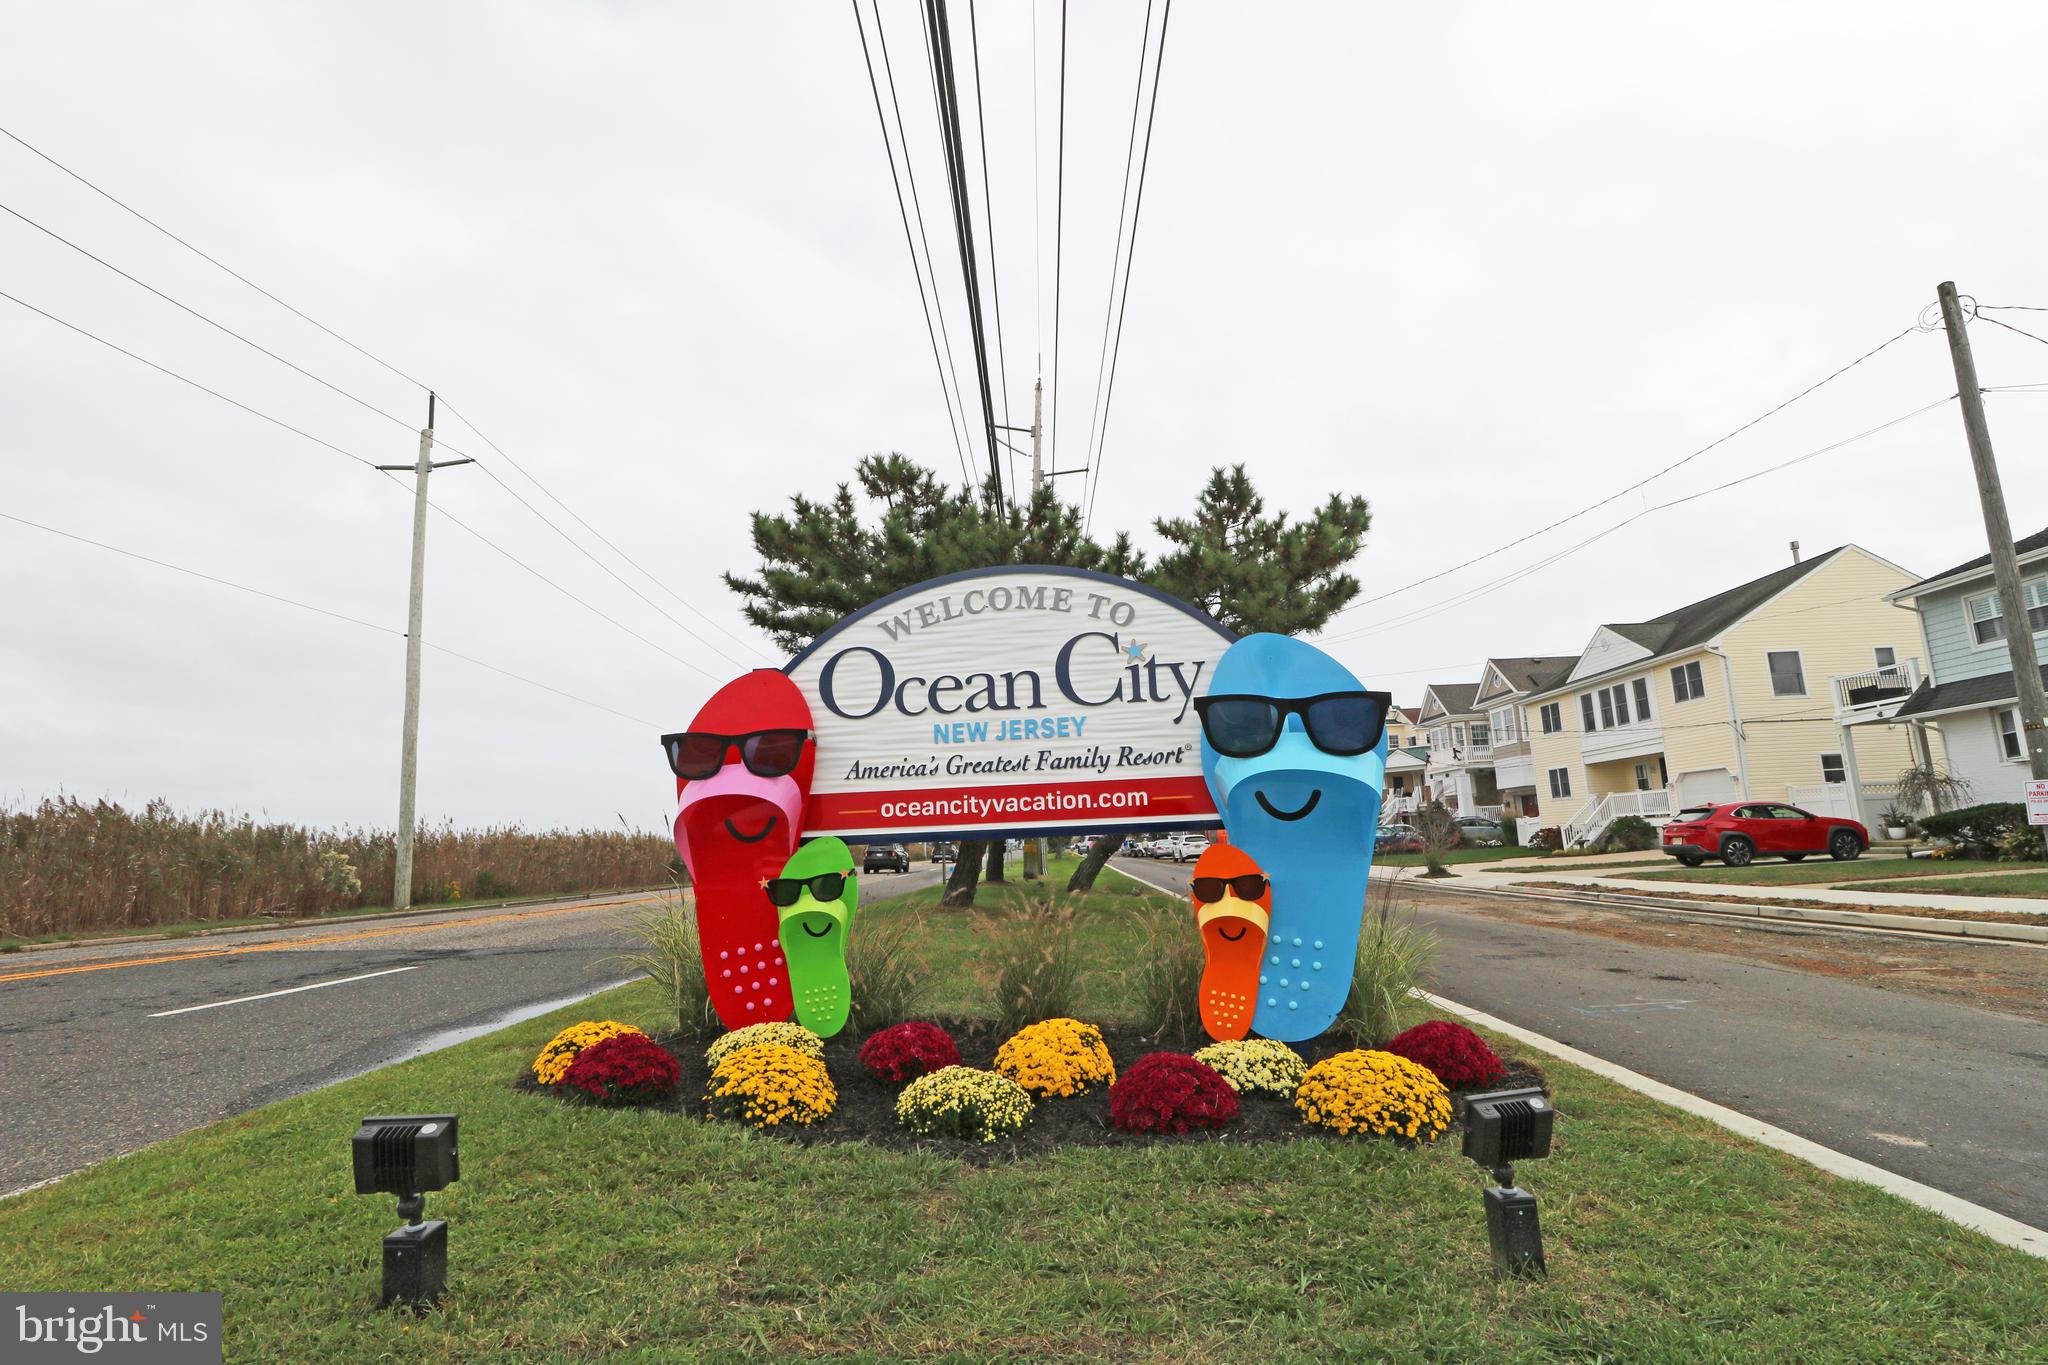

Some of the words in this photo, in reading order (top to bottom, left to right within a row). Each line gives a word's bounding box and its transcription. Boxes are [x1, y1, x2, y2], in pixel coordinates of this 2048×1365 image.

[878, 586, 1074, 641] WELCOME
[1088, 593, 1135, 627] TO
[818, 646, 1047, 719] Ocean
[1055, 631, 1205, 724] City
[933, 721, 988, 744] NEW
[995, 716, 1087, 741] JERSEY
[844, 755, 939, 780] America's
[946, 754, 1030, 776] Greatest
[1036, 746, 1111, 773] Family
[880, 790, 1148, 818] oceancityvacation.com
